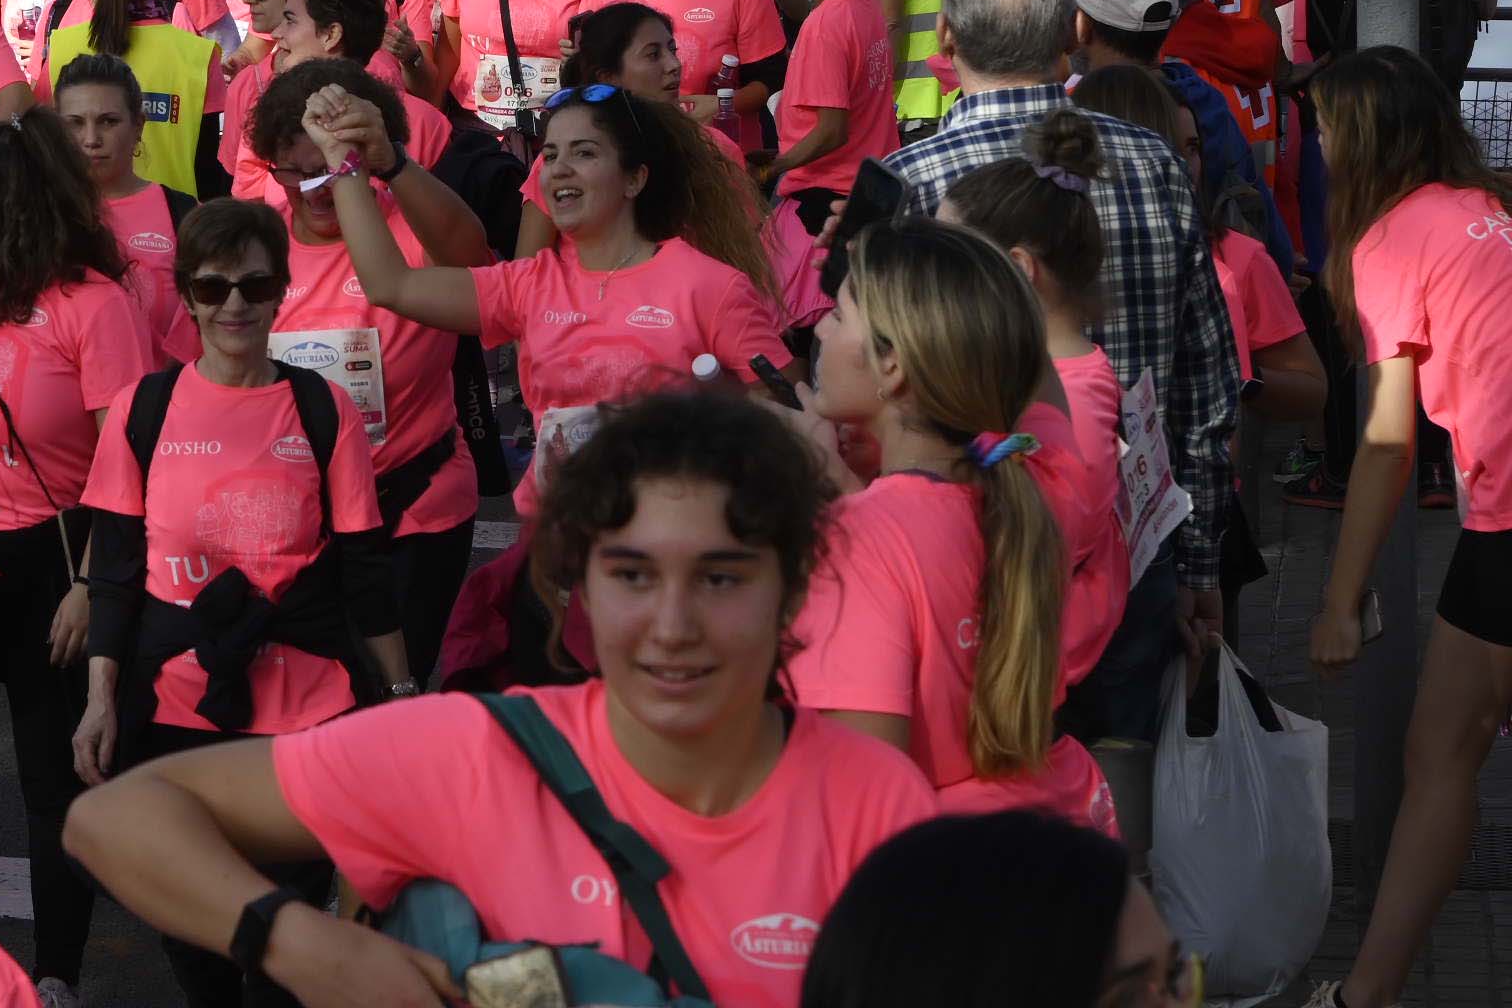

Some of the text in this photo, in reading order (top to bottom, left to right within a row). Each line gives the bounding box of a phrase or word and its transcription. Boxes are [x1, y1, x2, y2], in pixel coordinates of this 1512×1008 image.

[629, 312, 673, 327] ASTURIANA
[343, 344, 370, 353] SUMA
[284, 351, 339, 370] ASTURIANA
[160, 440, 222, 456] OYSHO
[166, 556, 209, 586] TU
[571, 874, 620, 906] OY
